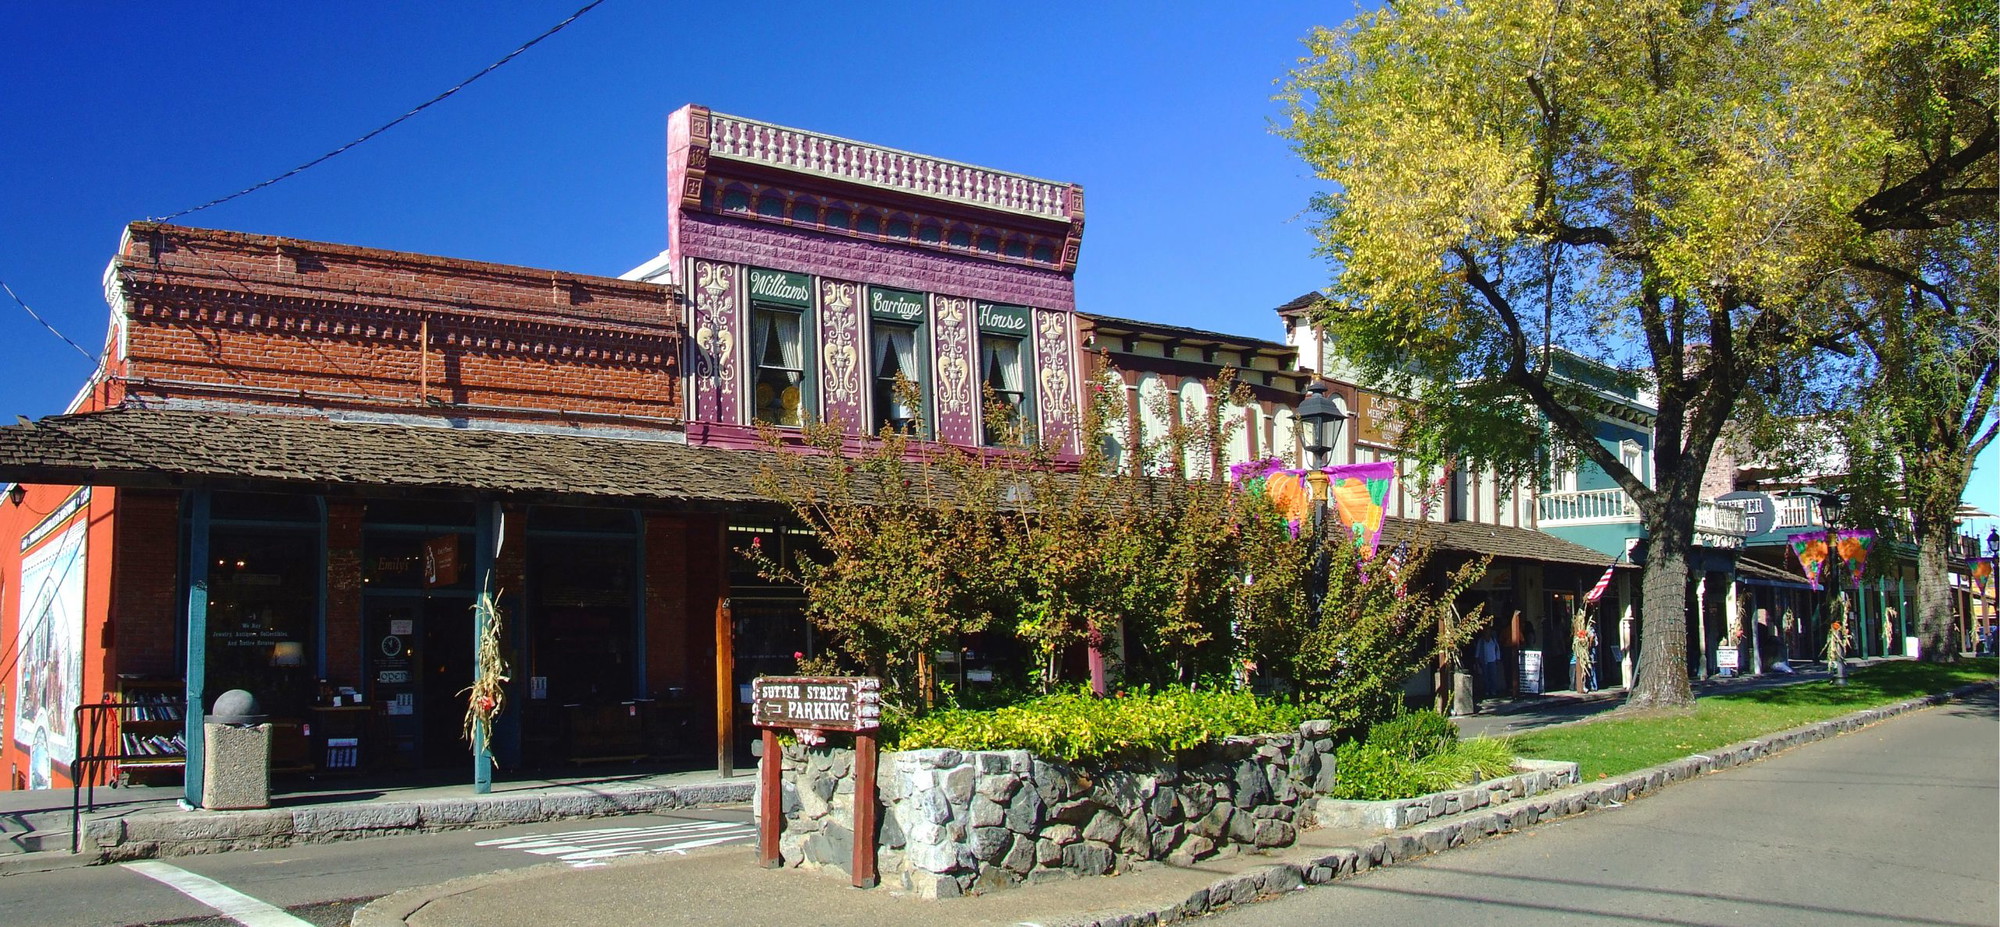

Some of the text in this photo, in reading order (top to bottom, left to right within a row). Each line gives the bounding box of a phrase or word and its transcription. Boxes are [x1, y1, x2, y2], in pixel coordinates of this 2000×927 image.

[750, 271, 1026, 330] Williams Carriage House
[1371, 397, 1403, 412] FOLSO
[762, 685, 848, 701] SUTTER STREET
[788, 701, 850, 721] PARKING
